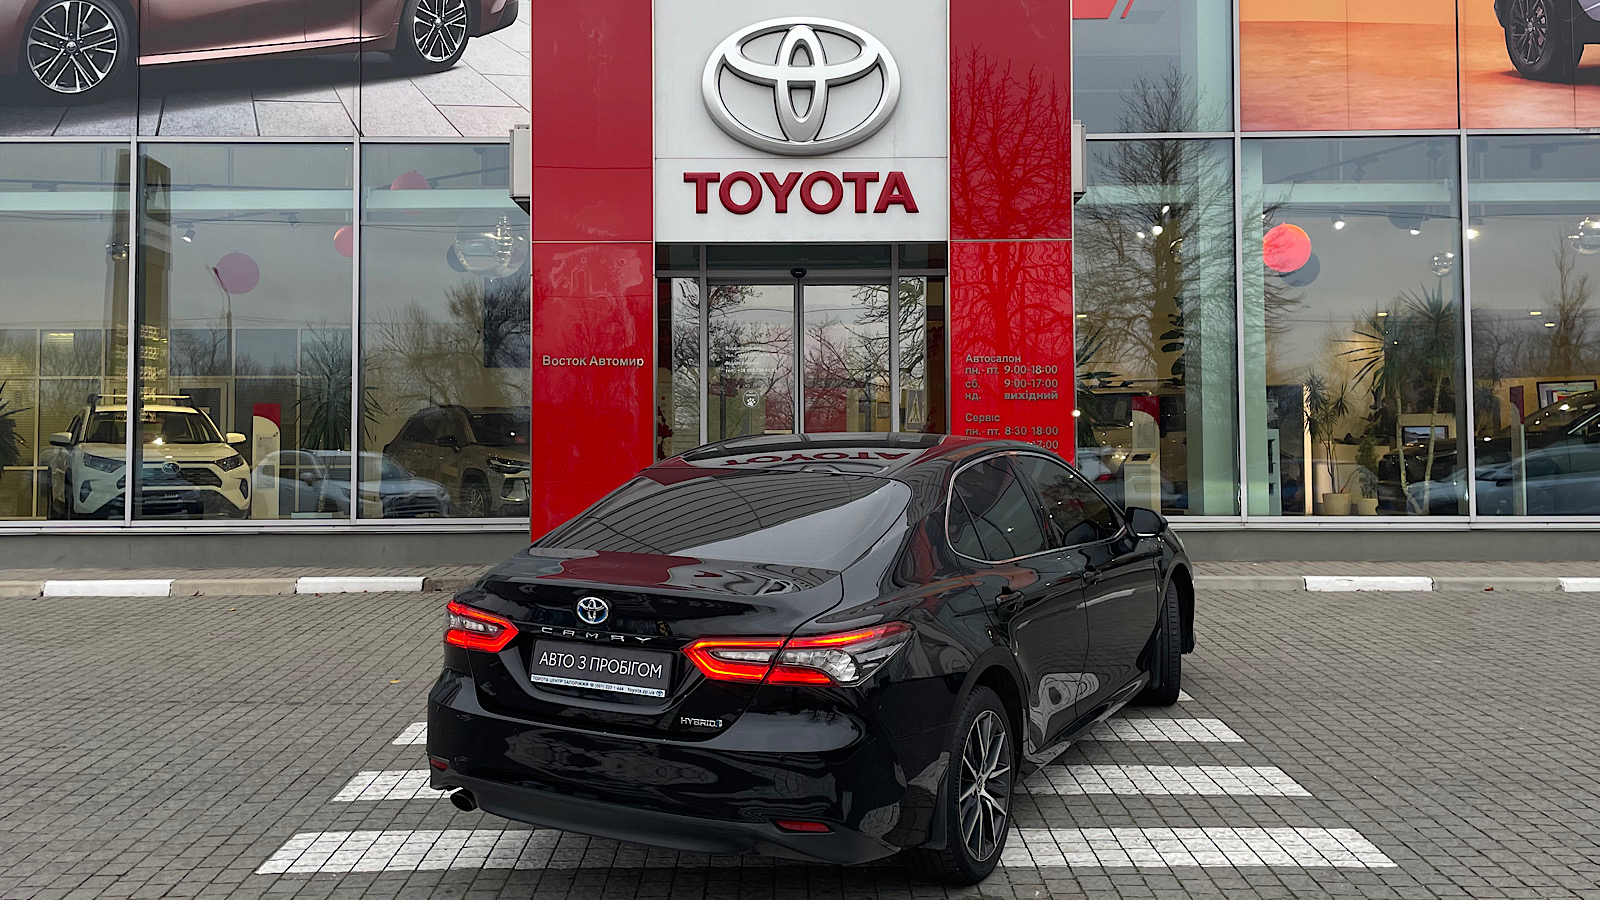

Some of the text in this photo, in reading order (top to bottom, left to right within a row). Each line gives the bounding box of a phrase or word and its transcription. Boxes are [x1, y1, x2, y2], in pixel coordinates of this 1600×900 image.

[683, 171, 920, 215] TOYOTA
[542, 355, 644, 369] Восток Автомир
[965, 354, 1022, 363] Автосалон
[965, 379, 1059, 388] сб. 9:00-17:00
[965, 391, 1058, 402] нд. вихідний
[965, 413, 1001, 424] Сервіс
[541, 626, 652, 643] CAMRY
[538, 651, 575, 669] АВТО
[589, 656, 663, 680] ПРОБІГОМ
[680, 716, 715, 728] HYBRID
